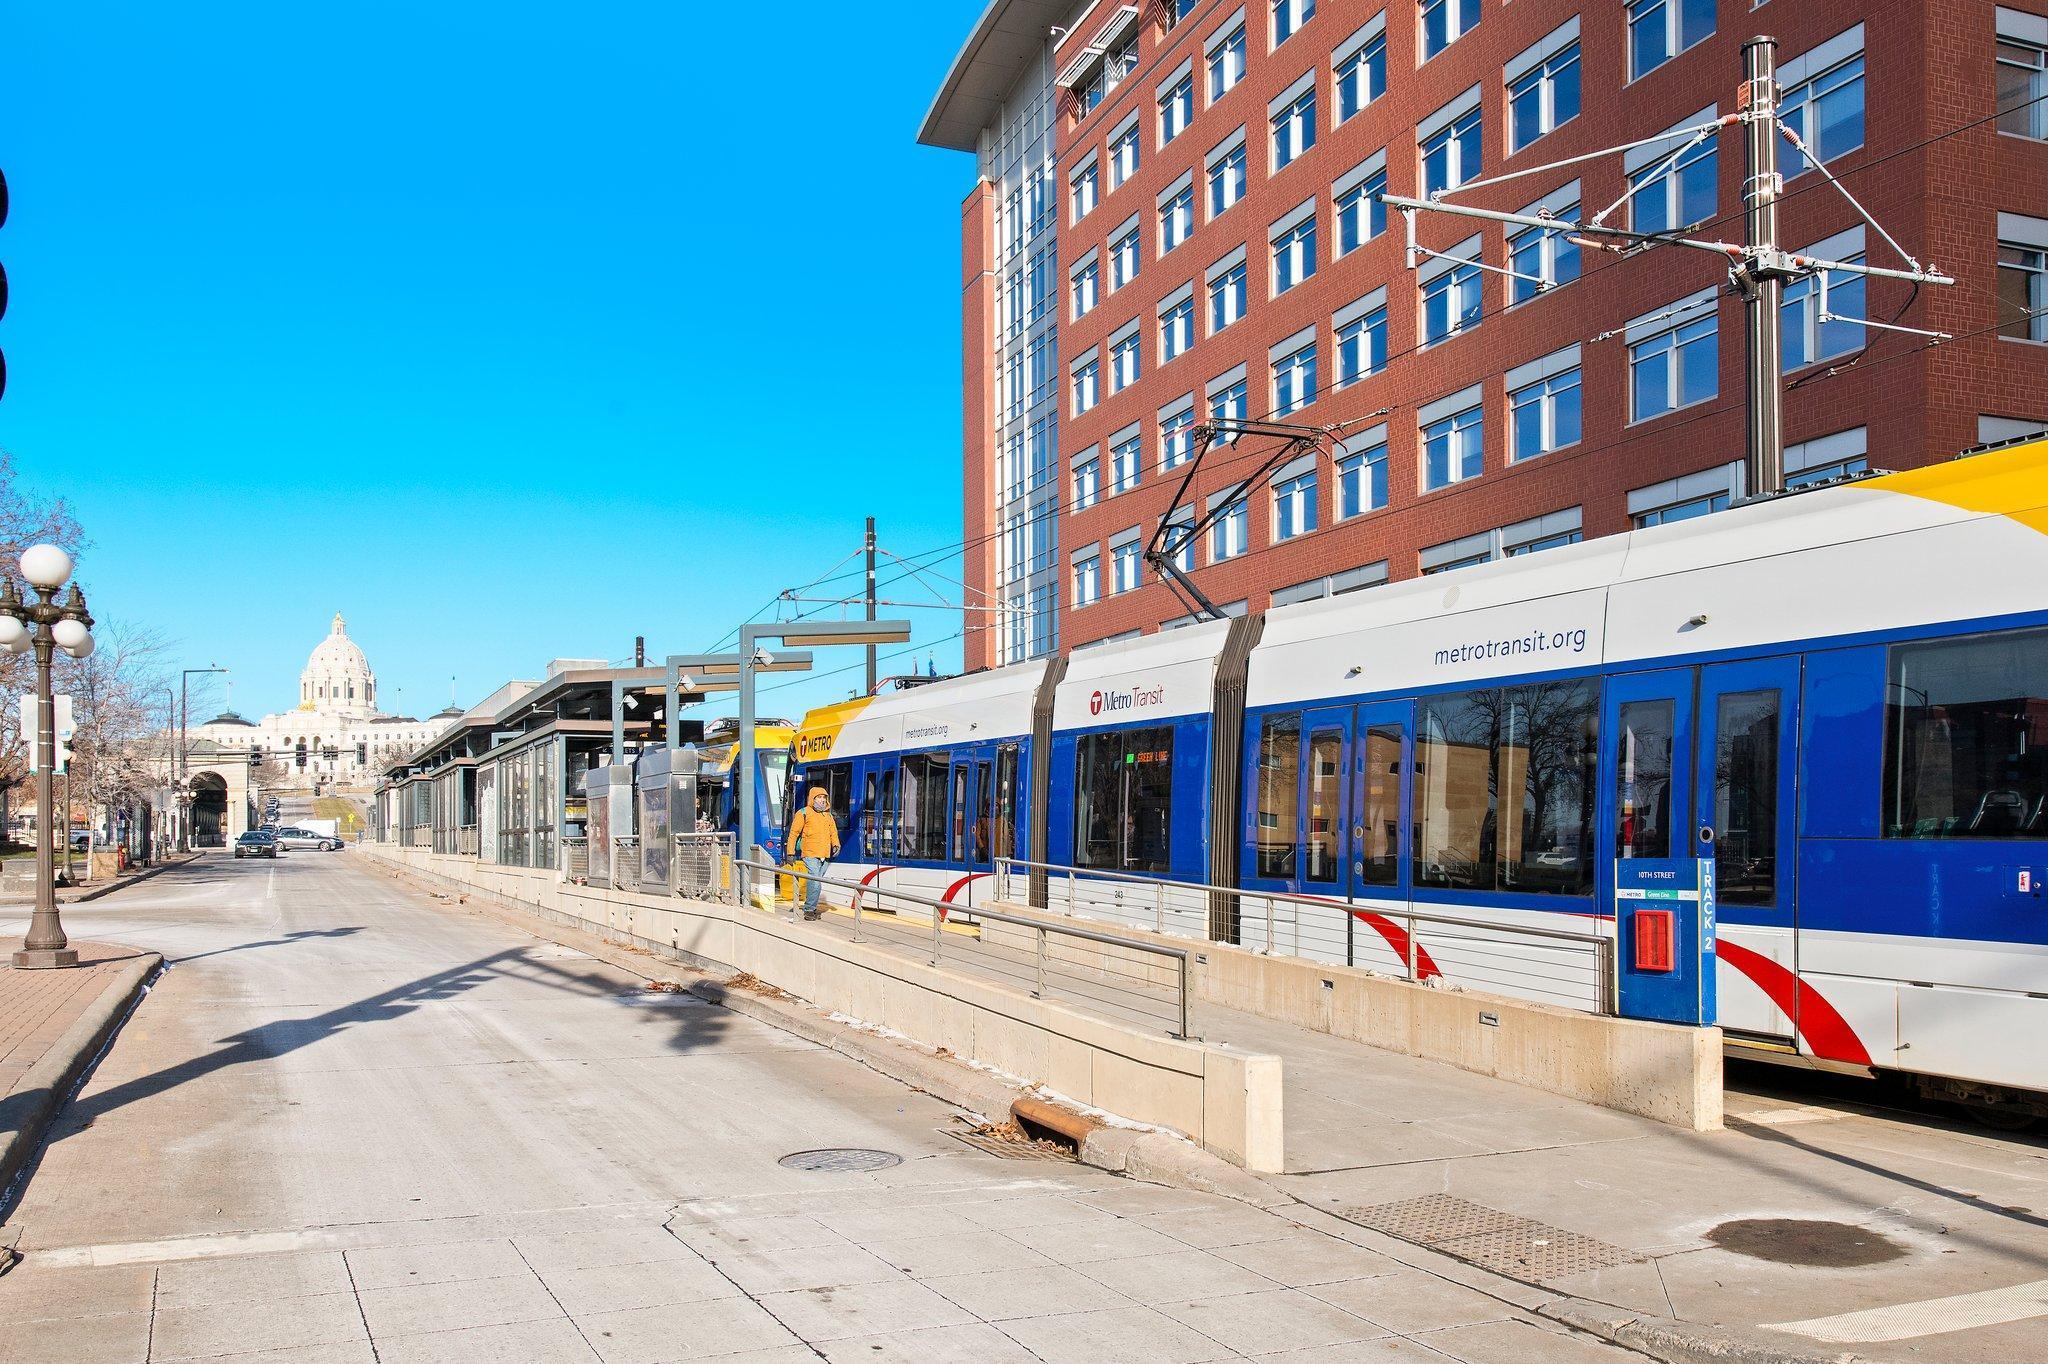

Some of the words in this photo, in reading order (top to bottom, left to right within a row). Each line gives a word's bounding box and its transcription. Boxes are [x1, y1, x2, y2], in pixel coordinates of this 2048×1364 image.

[1434, 629, 1586, 666] metrotransit.org
[905, 723, 949, 739] metrotransit.org
[807, 735, 832, 753] METRO
[1638, 871, 1653, 879] 10TH
[1653, 871, 1676, 879] STREET
[1703, 861, 1713, 930] TRACK
[1704, 937, 1712, 950] 2
